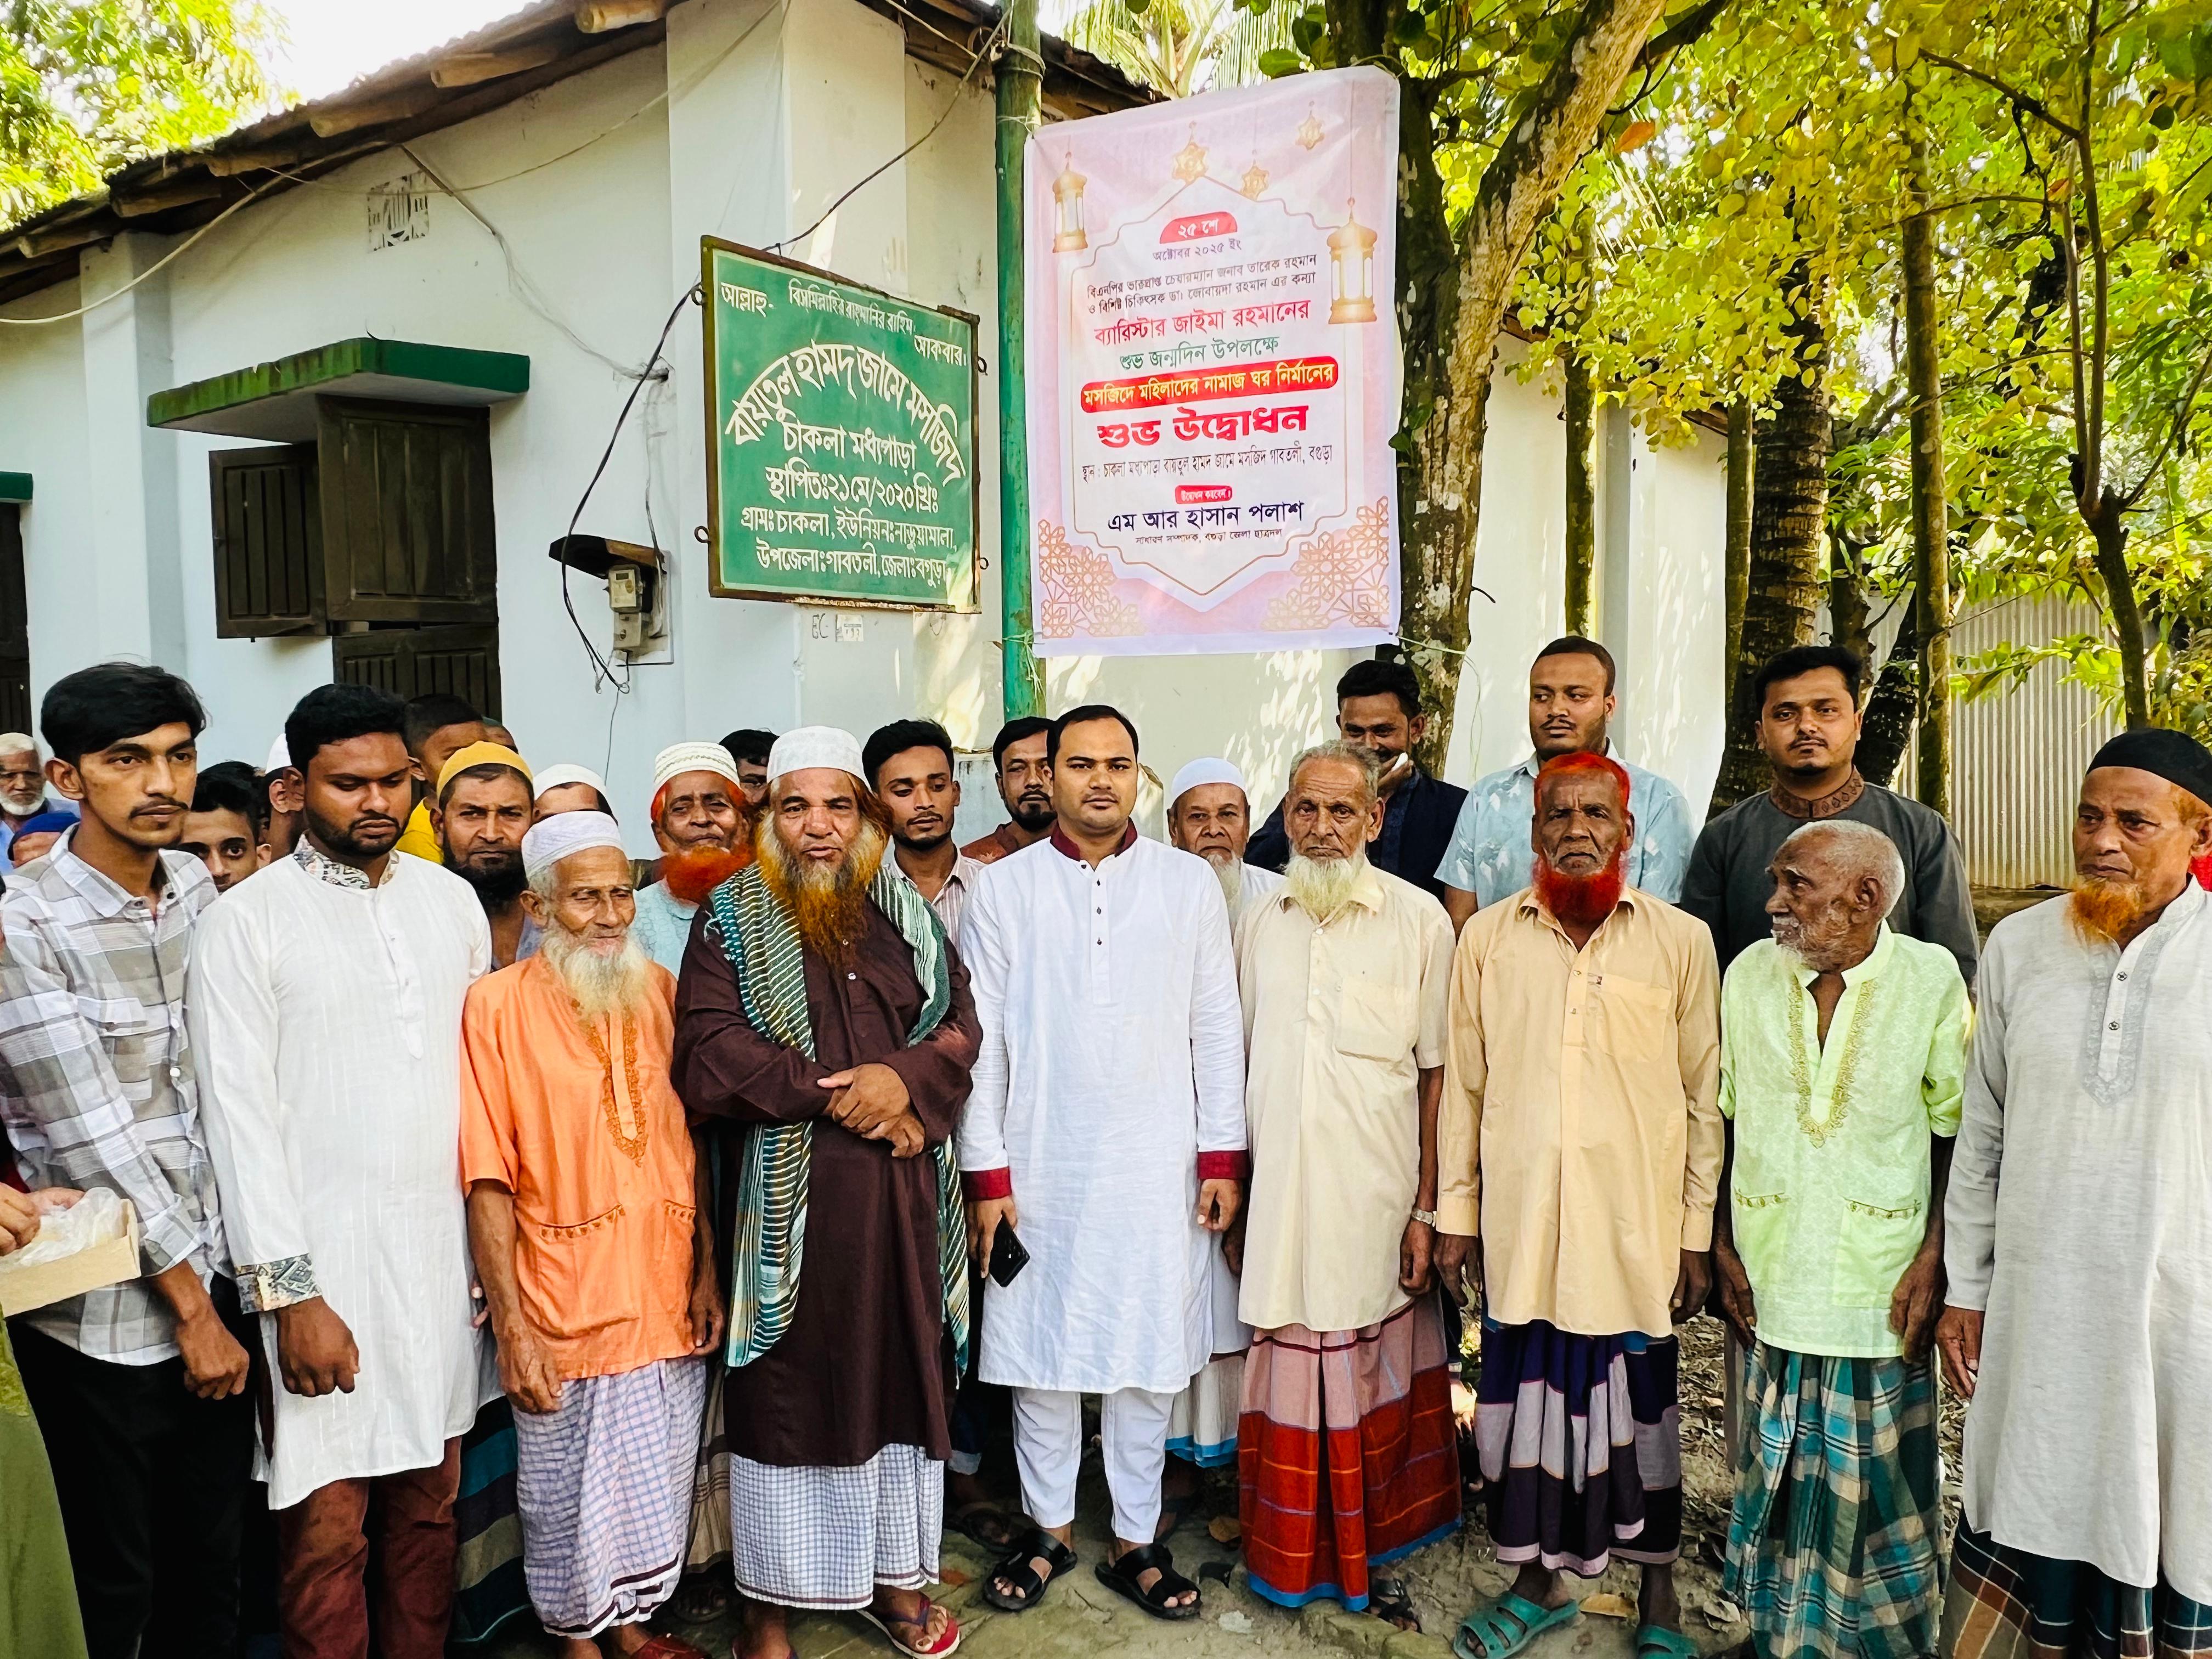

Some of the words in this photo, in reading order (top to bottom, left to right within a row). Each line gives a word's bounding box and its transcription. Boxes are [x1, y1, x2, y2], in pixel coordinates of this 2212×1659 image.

[1177, 223, 1197, 238] ২৫
[1195, 242, 1224, 256] ২০২৫
[1228, 238, 1242, 250] ইং
[1087, 280, 1123, 299] বিএনপির
[1217, 264, 1243, 278] জনাব
[1246, 259, 1280, 273] তারেক
[1284, 253, 1317, 269] রহমান
[1088, 305, 1095, 314] ও
[1125, 292, 1165, 309] চিকিৎসক
[1236, 278, 1267, 293] রহমান
[1271, 275, 1287, 287] এর
[1291, 271, 1316, 285] কন্যা
[1094, 316, 1166, 346] ব্যারিস্টার
[1172, 308, 1226, 334] জাইমা
[1232, 300, 1311, 328] রহমানের
[1120, 353, 1144, 370] শুভ
[1149, 341, 1206, 368] জন্মদিন
[1211, 336, 1280, 359] উপলক্ষে
[1083, 383, 1135, 405] মসজিদে
[1139, 377, 1200, 400] মহিলাদের
[1201, 373, 1246, 394] নামাজ
[1250, 370, 1272, 388] ঘর
[1276, 359, 1335, 386] নির্মানের
[790, 338, 857, 400] হামদ
[856, 346, 909, 411] জামে
[905, 380, 966, 487] মসজিদ
[1097, 420, 1161, 448] শুভ
[1172, 404, 1309, 441] উদ্বোধন
[782, 418, 847, 459] চাকলা
[848, 427, 917, 476] মধ্যপাড়া
[1215, 453, 1235, 468] জামে
[1238, 445, 1266, 466] মসজিদ
[1108, 514, 1137, 532] এম
[1142, 510, 1180, 530] আর
[1186, 504, 1241, 530] হাসান
[1249, 500, 1305, 522] পলাশ
